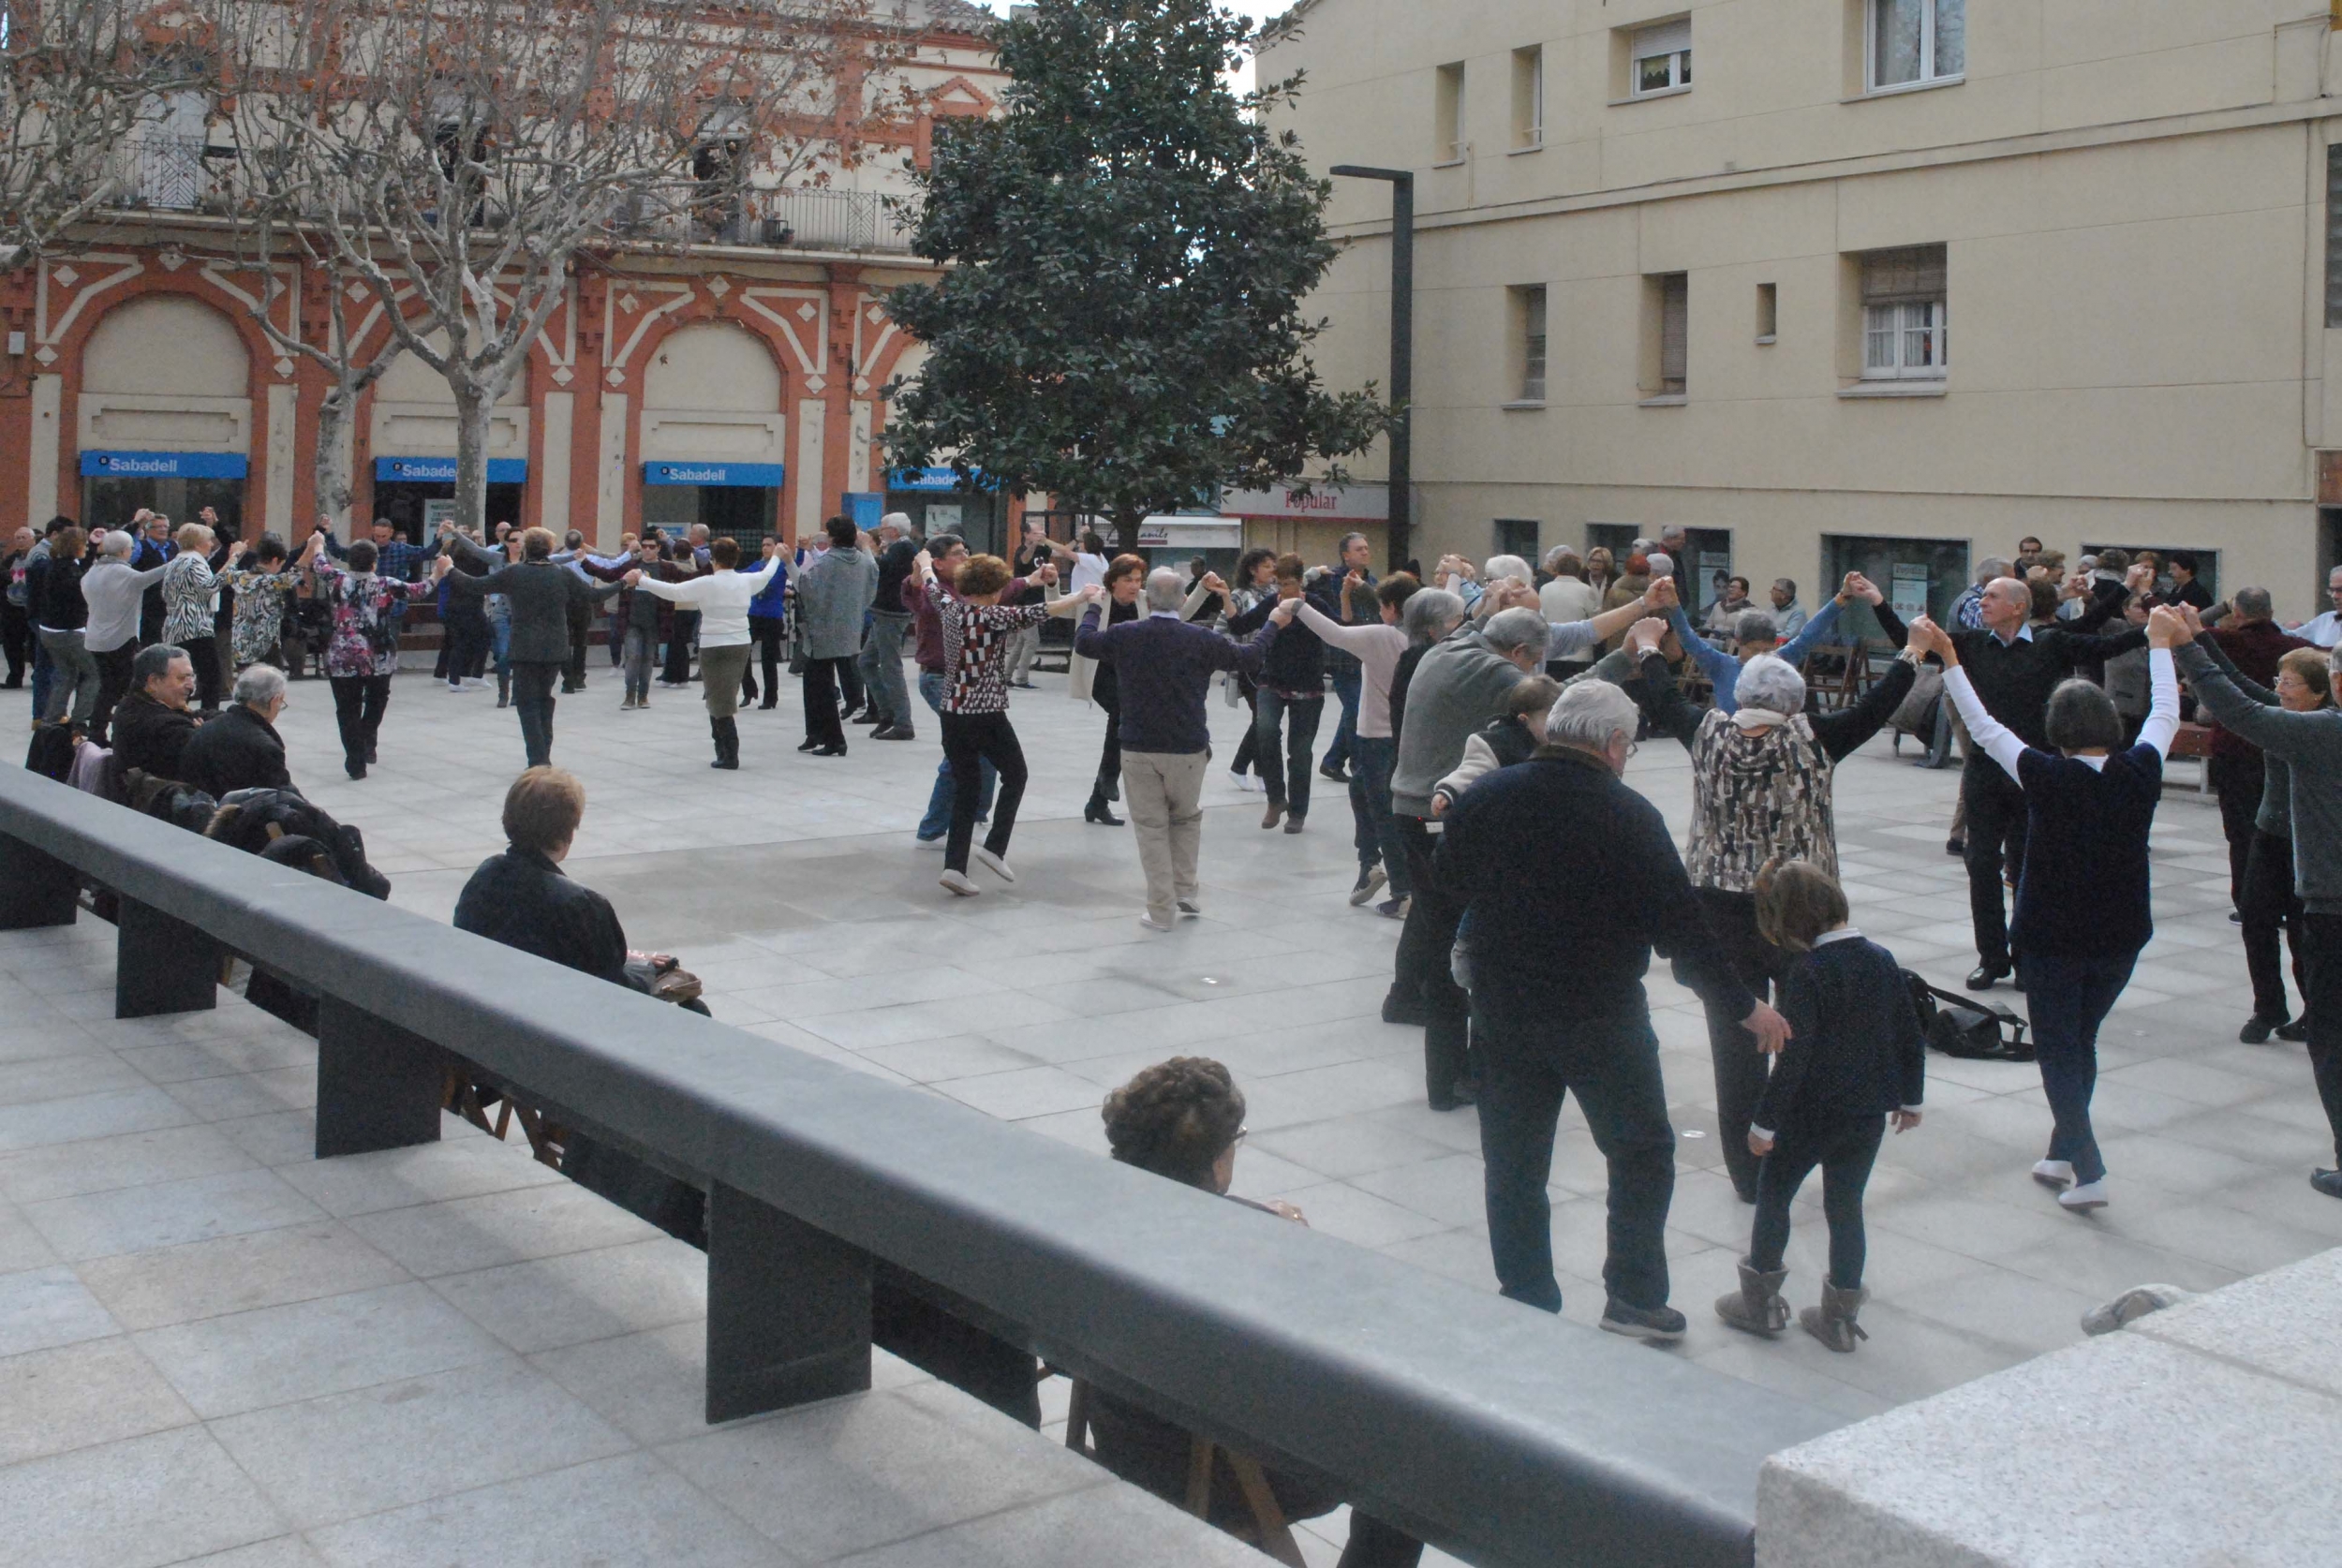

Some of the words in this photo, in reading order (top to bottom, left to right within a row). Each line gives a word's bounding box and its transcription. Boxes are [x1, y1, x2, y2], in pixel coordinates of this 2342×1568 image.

[109, 458, 178, 472] Sabadell
[402, 464, 455, 477] Sabade
[669, 468, 726, 481] Sabadell
[912, 474, 961, 485] abade
[1285, 490, 1337, 512] Popular
